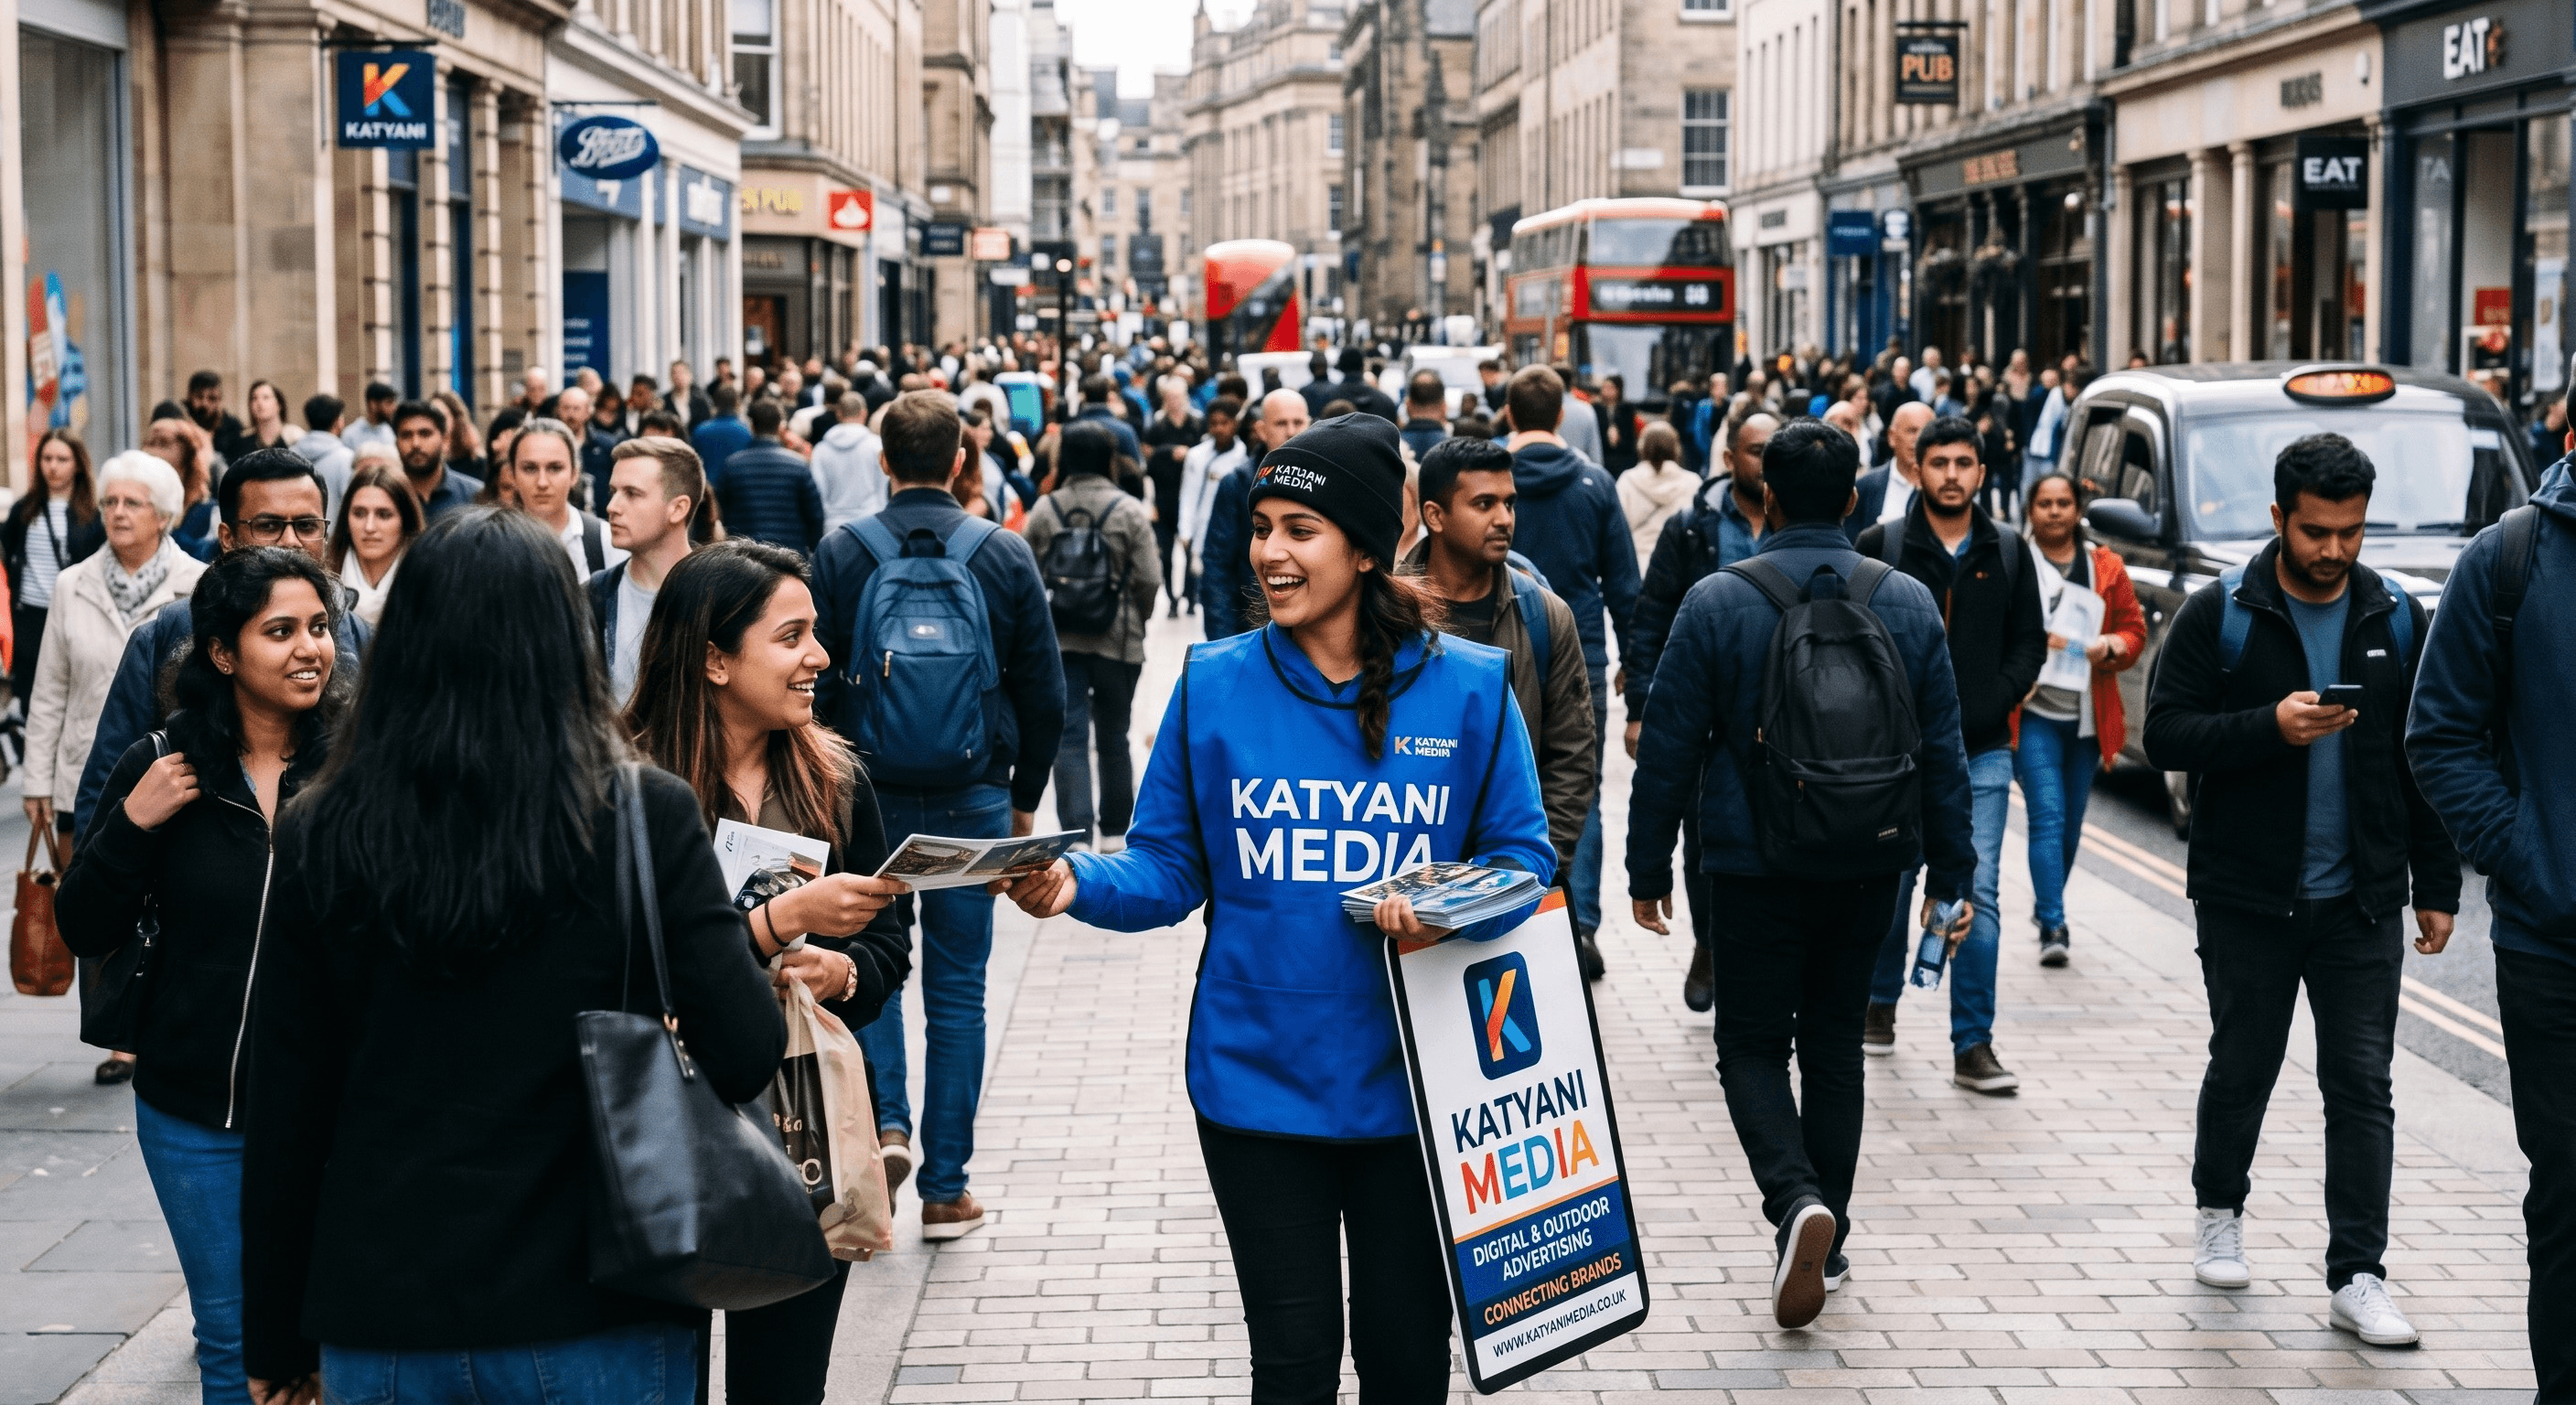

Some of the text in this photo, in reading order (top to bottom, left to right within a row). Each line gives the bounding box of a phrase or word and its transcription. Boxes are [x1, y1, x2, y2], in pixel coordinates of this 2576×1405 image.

[1902, 54, 1954, 81] PUB
[2443, 16, 2489, 80] EAT
[346, 121, 426, 140] KATYANI
[2303, 156, 2363, 184] EAT
[1273, 475, 1313, 492] MEDIA
[1415, 736, 1458, 748] KATYANI
[1231, 778, 1450, 825] KATYANI
[1236, 828, 1432, 883] MEDIA
[1451, 1068, 1588, 1153] KATYANI
[1461, 1119, 1600, 1215] MEDIA
[1473, 1196, 1610, 1267] DIGITAL & OUTDOOR
[1503, 1228, 1593, 1281] ADVERTISING
[1484, 1252, 1622, 1325] CONNECTING BRANDS
[1492, 1289, 1626, 1357] WWW.KATYANIMEDIA.CO.UK
